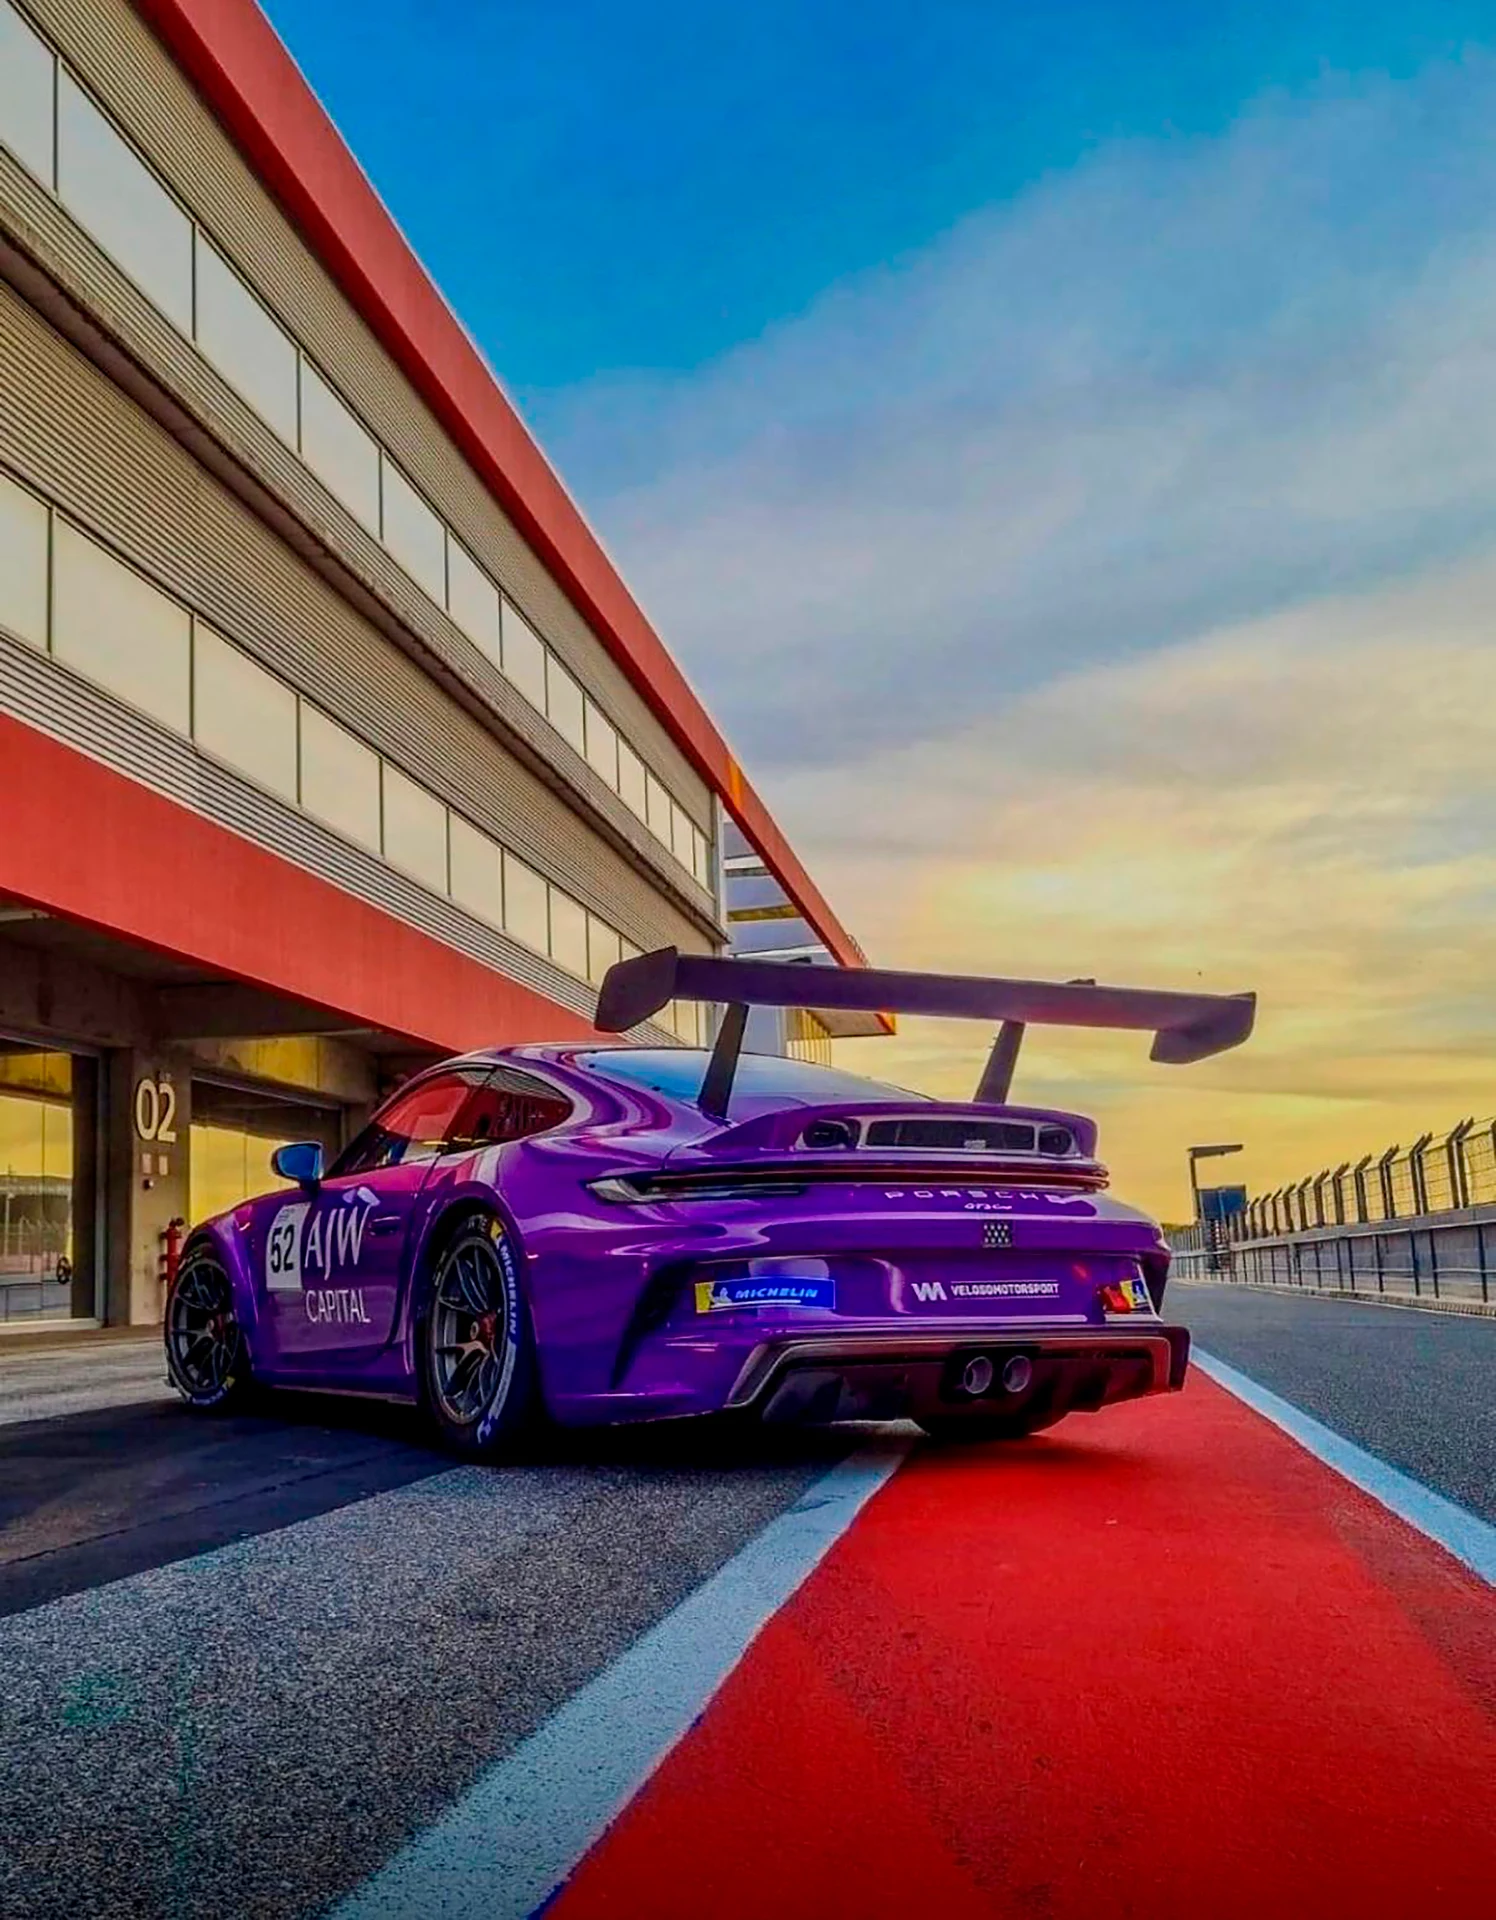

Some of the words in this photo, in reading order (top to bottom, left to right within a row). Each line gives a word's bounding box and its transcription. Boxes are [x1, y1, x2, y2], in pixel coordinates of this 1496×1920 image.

[135, 1078, 176, 1142] 02
[270, 1223, 295, 1274] 52
[304, 1203, 373, 1281] AJW
[305, 1288, 371, 1324] CAPITAL
[500, 1245, 517, 1335] MICHELIN
[735, 1287, 819, 1299] MICHELIN
[951, 1284, 1060, 1296] VELOSOMOTORSPORT
